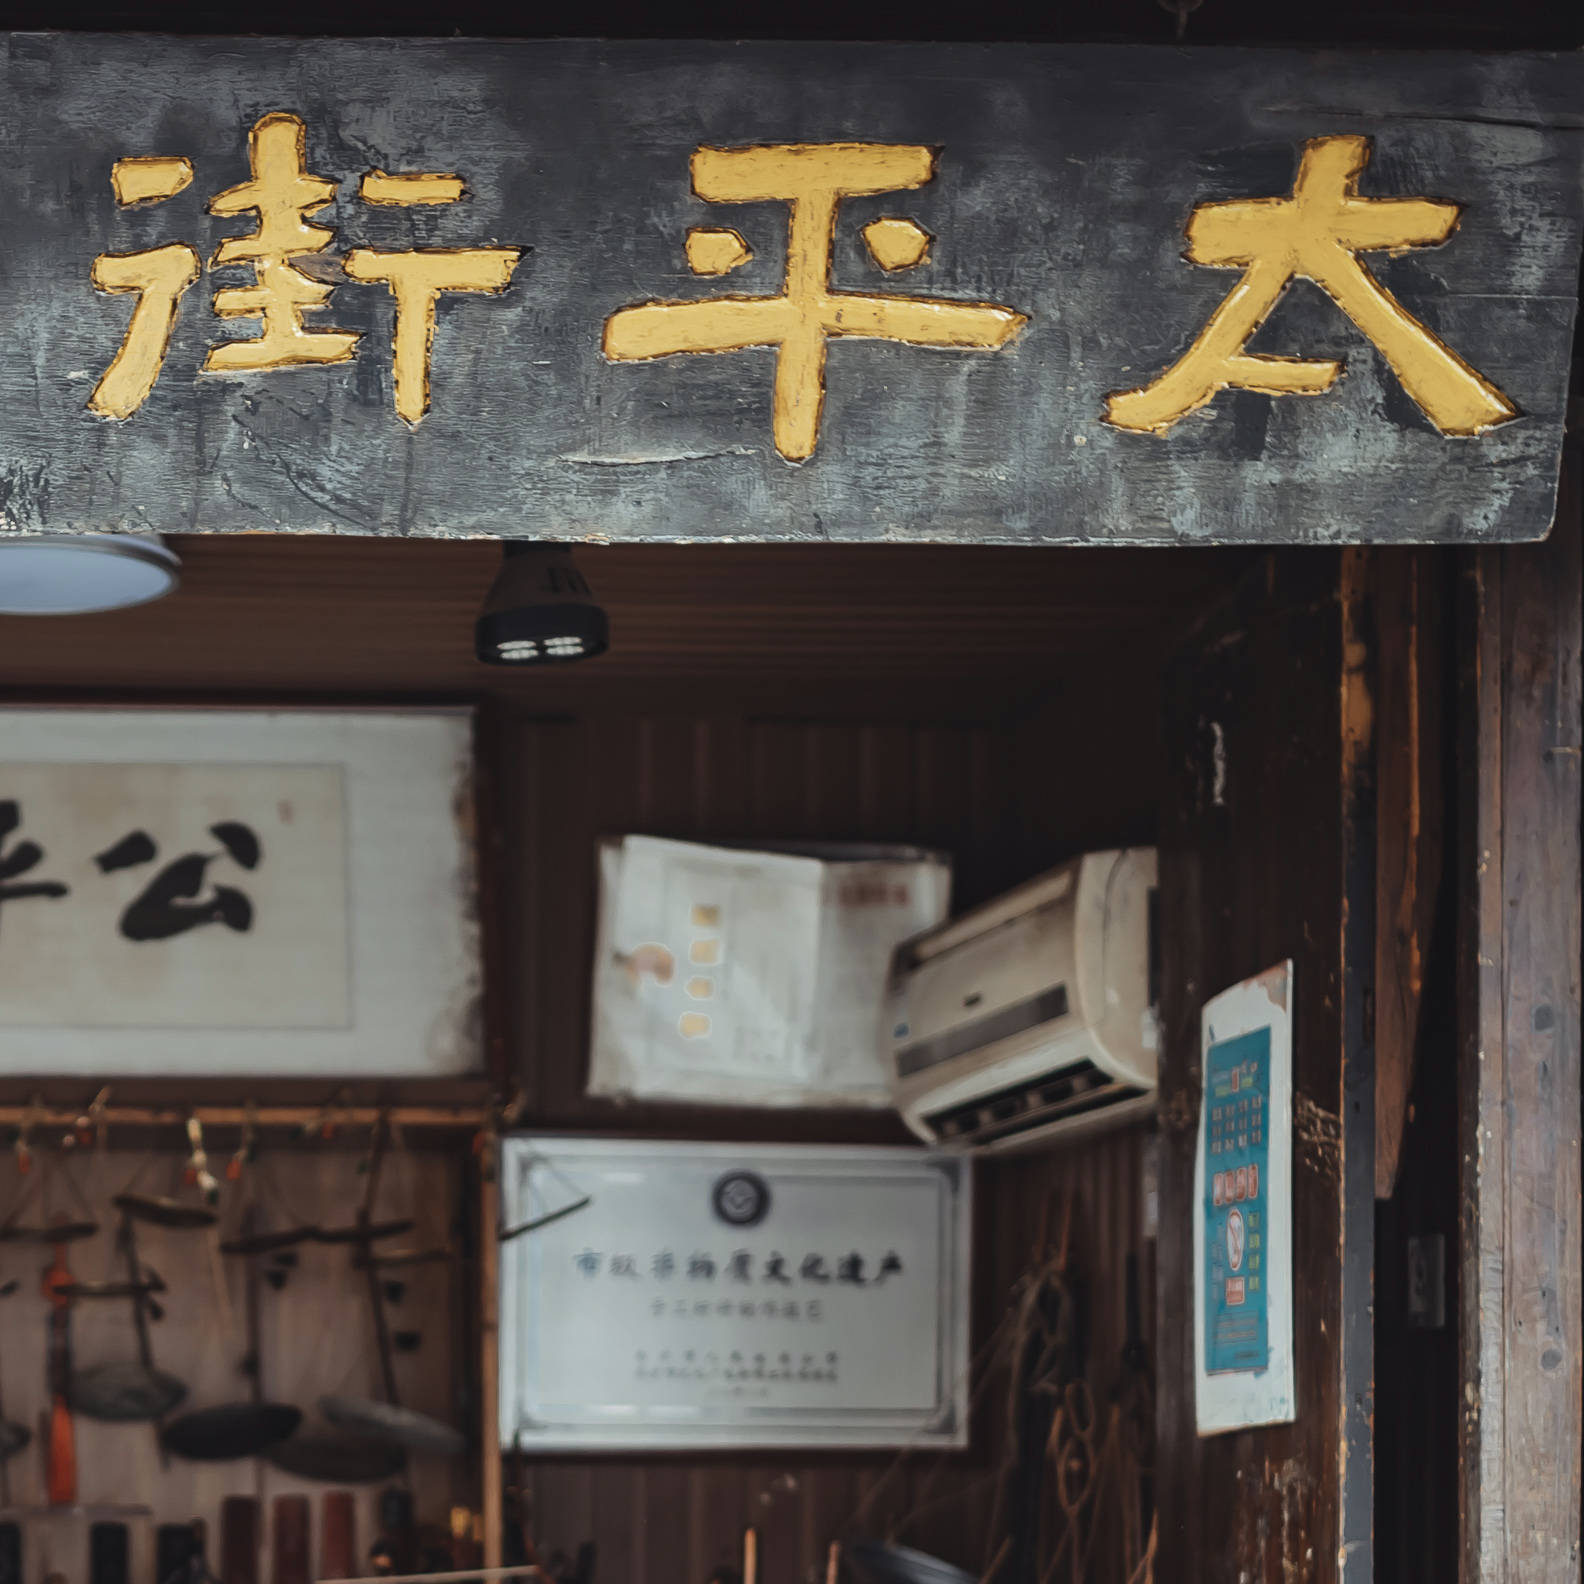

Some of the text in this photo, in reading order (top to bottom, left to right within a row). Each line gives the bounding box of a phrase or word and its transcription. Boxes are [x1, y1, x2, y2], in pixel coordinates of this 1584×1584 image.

[573, 1248, 905, 1291] 市级非物质文化遗产
